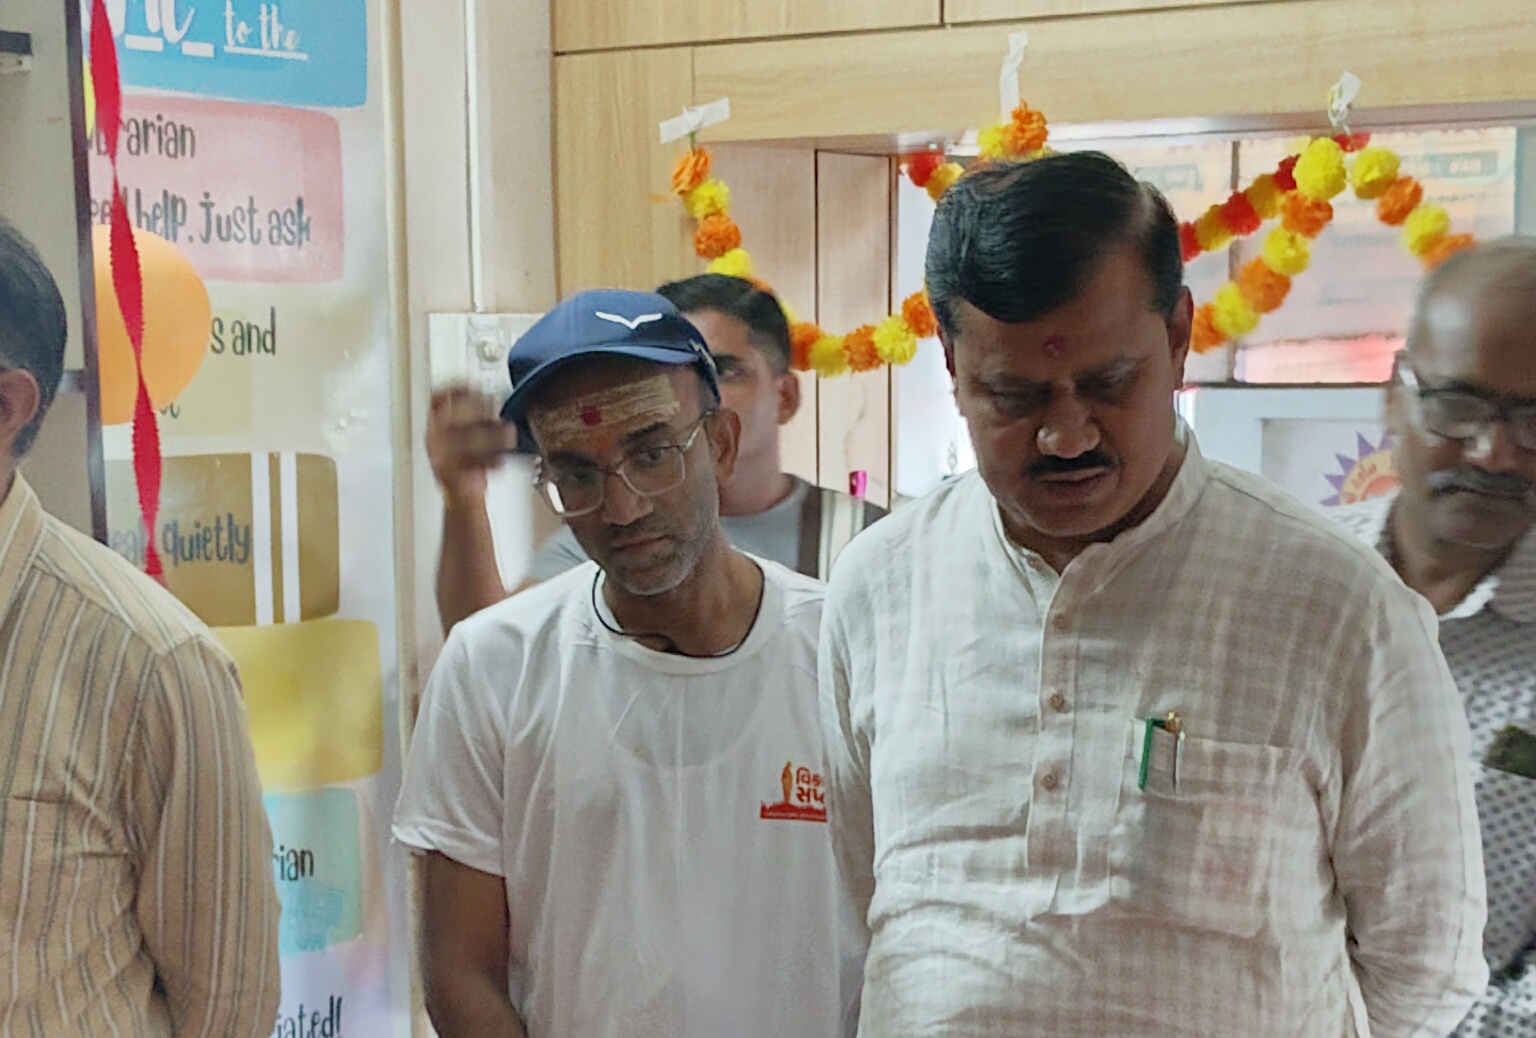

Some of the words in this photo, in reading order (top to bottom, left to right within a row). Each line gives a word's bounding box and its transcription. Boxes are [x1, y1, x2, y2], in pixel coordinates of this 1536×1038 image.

[223, 1, 253, 48] to
[260, 3, 300, 50] the
[268, 196, 312, 249] ask
[231, 305, 277, 356] and
[162, 512, 253, 569] quietly
